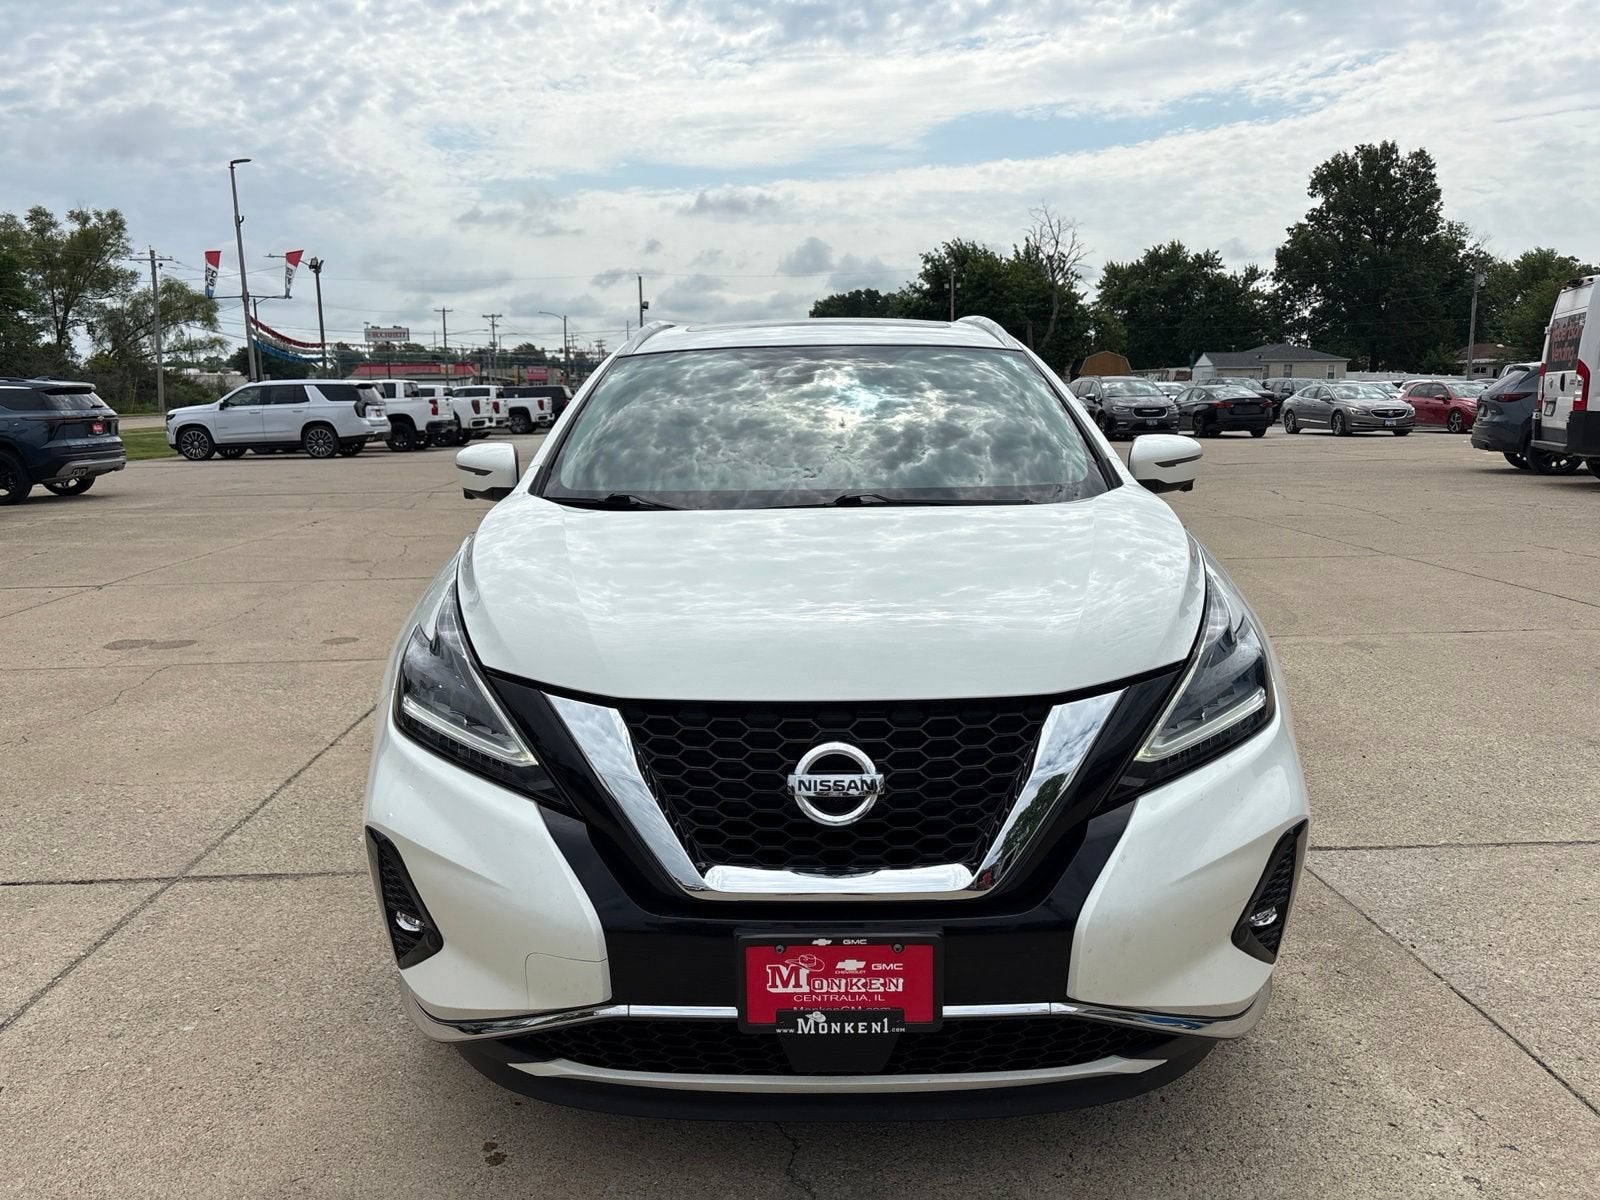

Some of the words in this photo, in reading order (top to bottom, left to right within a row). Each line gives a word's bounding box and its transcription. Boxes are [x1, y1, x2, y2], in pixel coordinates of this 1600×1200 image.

[798, 779, 877, 792] NISSAN
[871, 963, 903, 971] GMC
[793, 994, 871, 1003] CENTRALIA,
[875, 994, 885, 1002] IL
